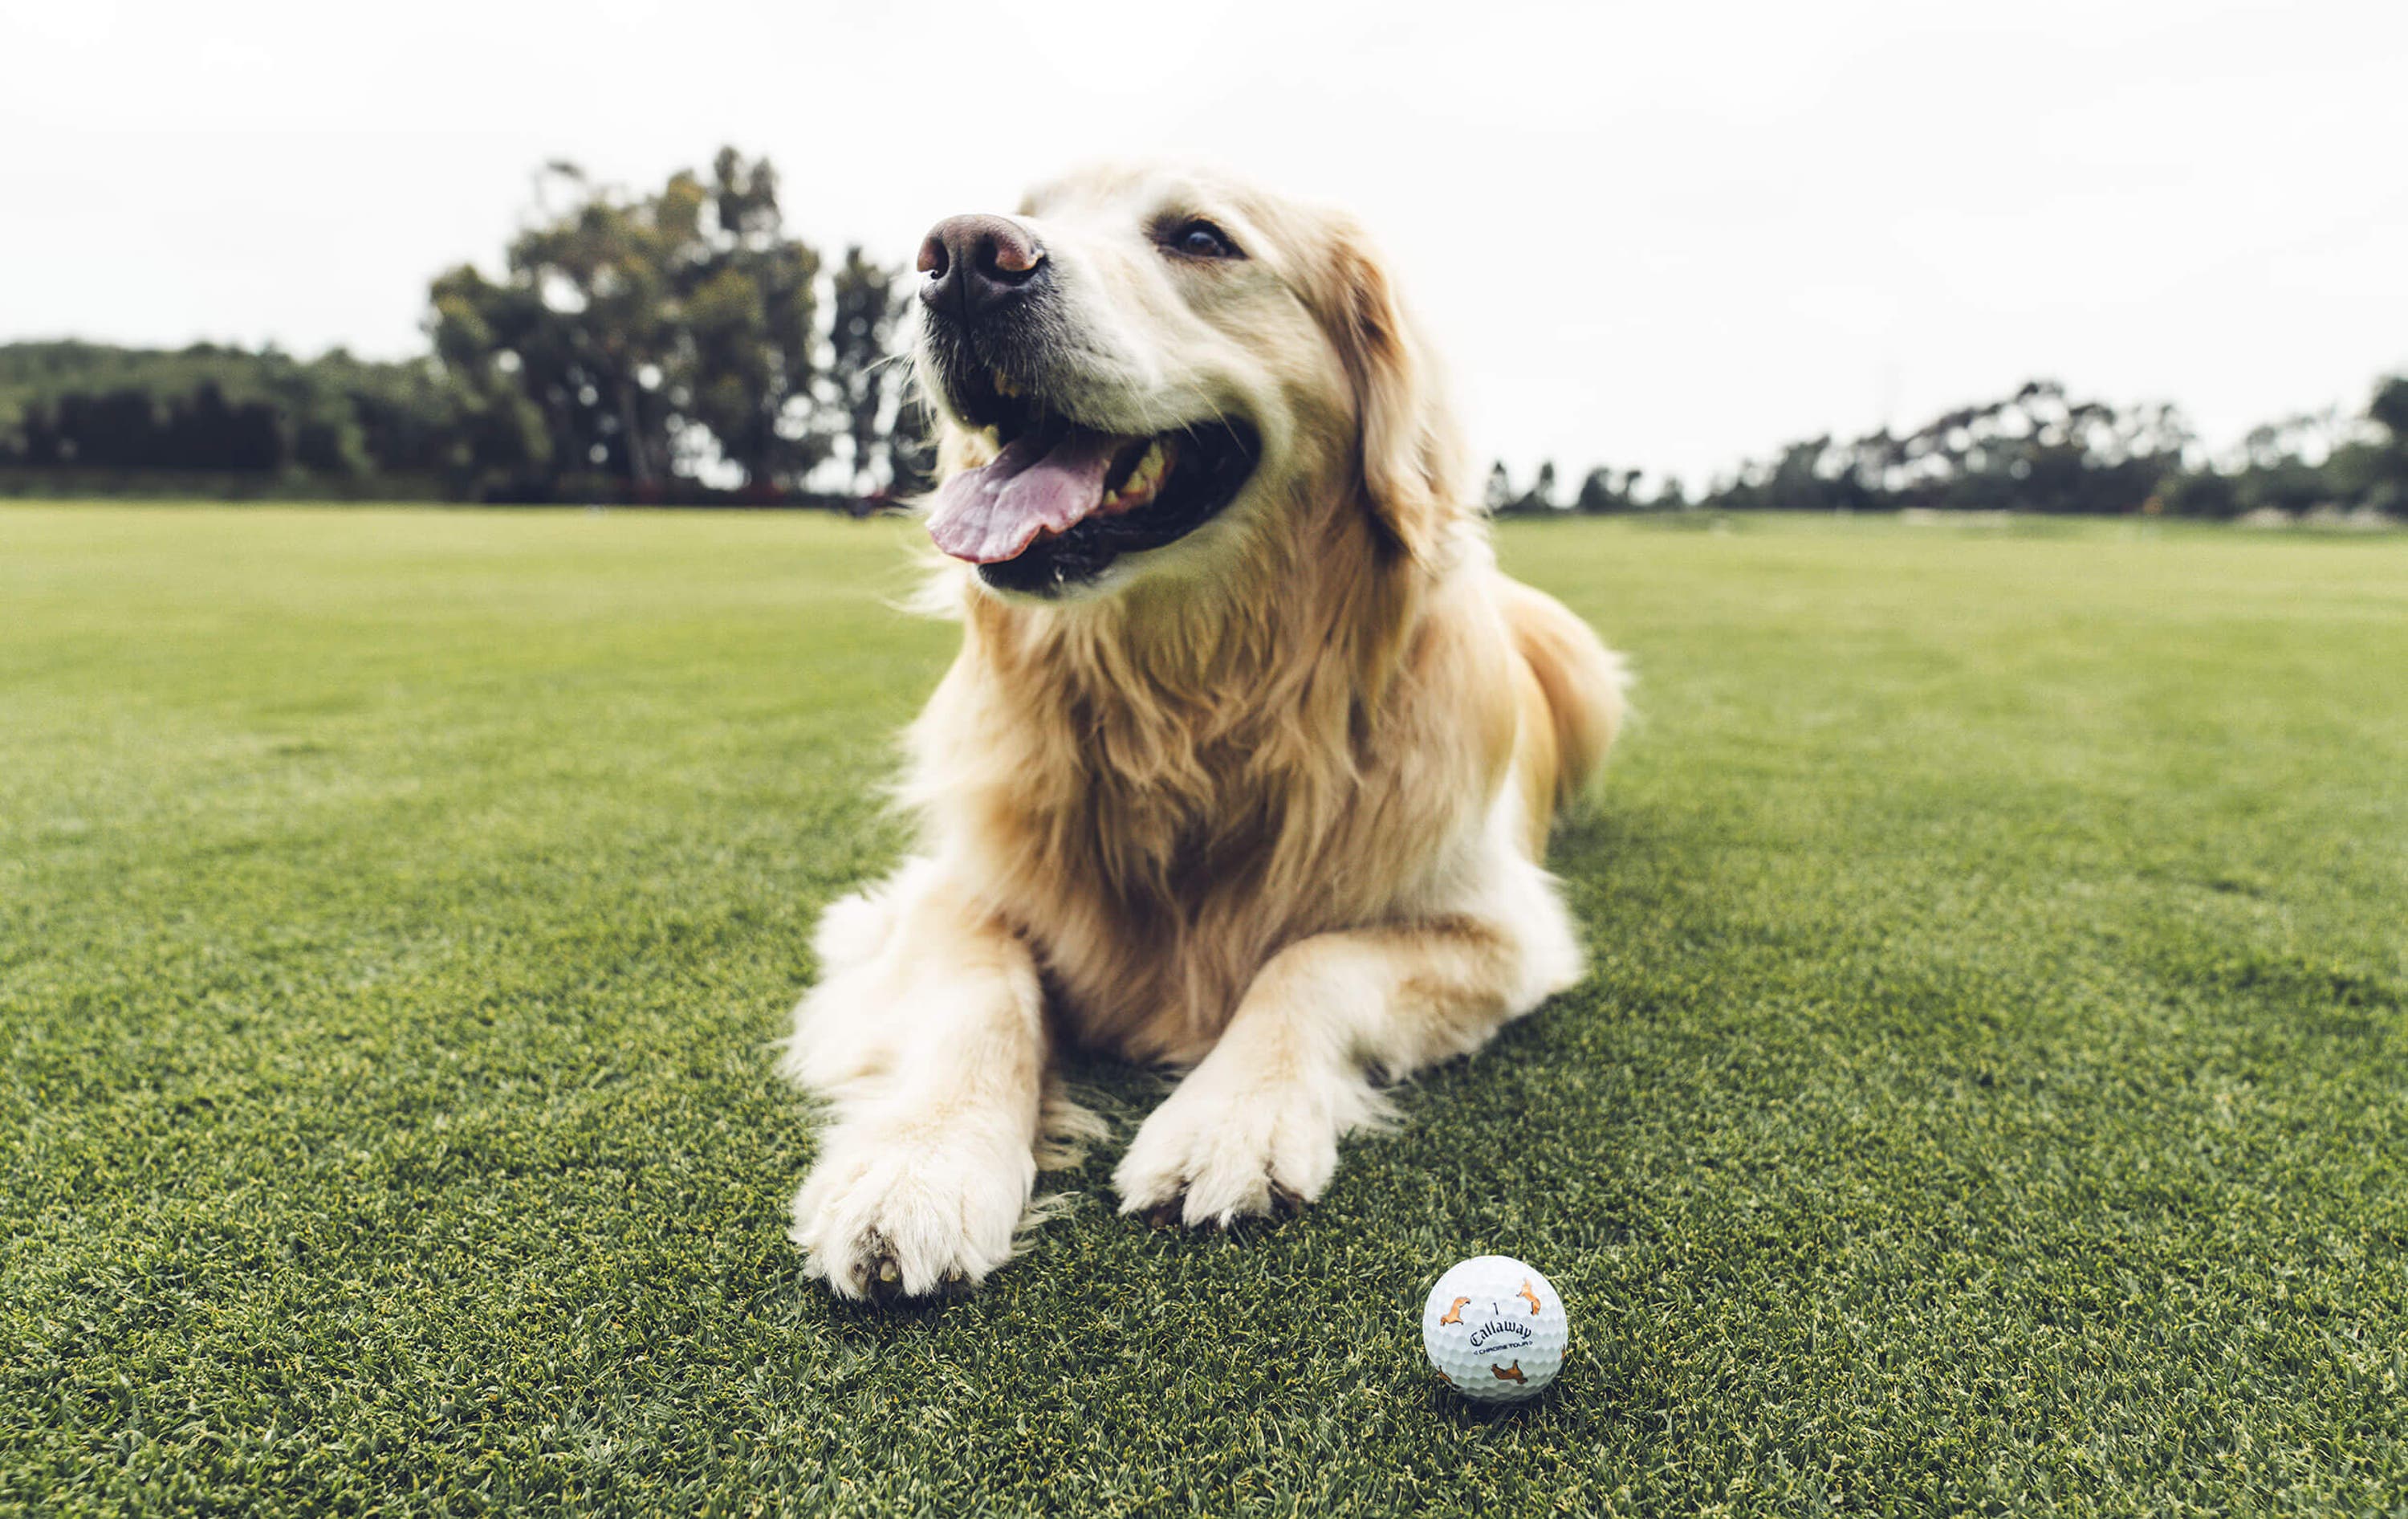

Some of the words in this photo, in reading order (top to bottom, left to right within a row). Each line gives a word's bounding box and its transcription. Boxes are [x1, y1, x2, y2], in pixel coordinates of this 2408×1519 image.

[1493, 1302, 1499, 1315] 1
[1470, 1321, 1531, 1346] Callaway
[1479, 1345, 1507, 1355] CHROME
